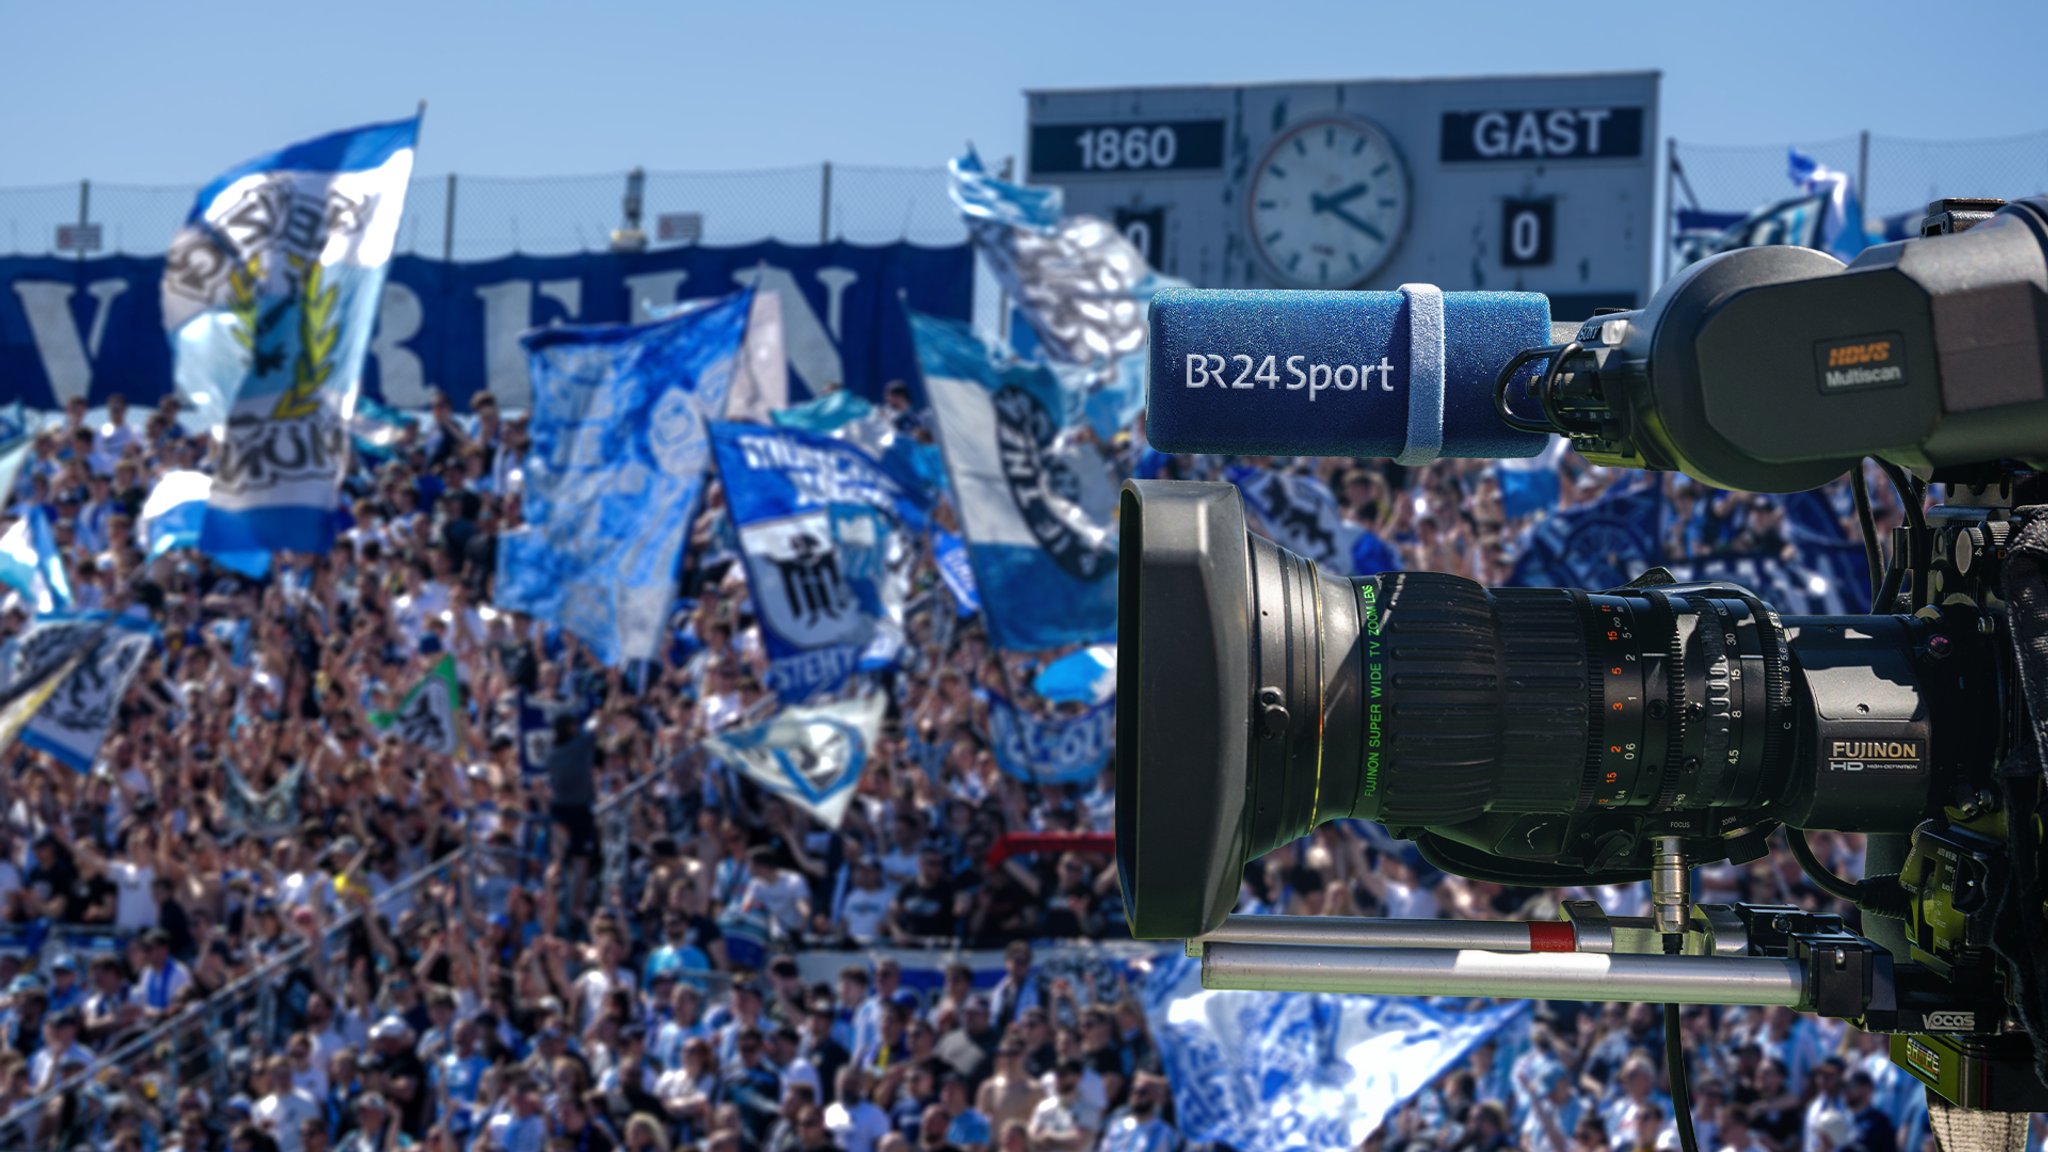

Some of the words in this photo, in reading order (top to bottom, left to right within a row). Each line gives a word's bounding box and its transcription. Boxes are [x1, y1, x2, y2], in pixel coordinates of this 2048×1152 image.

[1473, 110, 1611, 156] GAST
[1077, 126, 1176, 169] 1860
[1511, 211, 1539, 260] 0
[1286, 355, 1395, 401] Sport
[1825, 366, 1901, 388] Multiscan
[1366, 606, 1380, 636] ZOOM
[1369, 641, 1381, 657] TV
[1725, 633, 1737, 646] 30
[1370, 663, 1382, 698] WIDE
[1730, 668, 1741, 681] 15
[1612, 702, 1623, 711] 3
[1731, 710, 1742, 719] 8
[1368, 704, 1382, 748] SUPER
[1611, 745, 1622, 753] 2
[1832, 742, 1916, 758] FUJINON
[1364, 752, 1380, 797] FUJINON
[1830, 761, 1864, 771] HD
